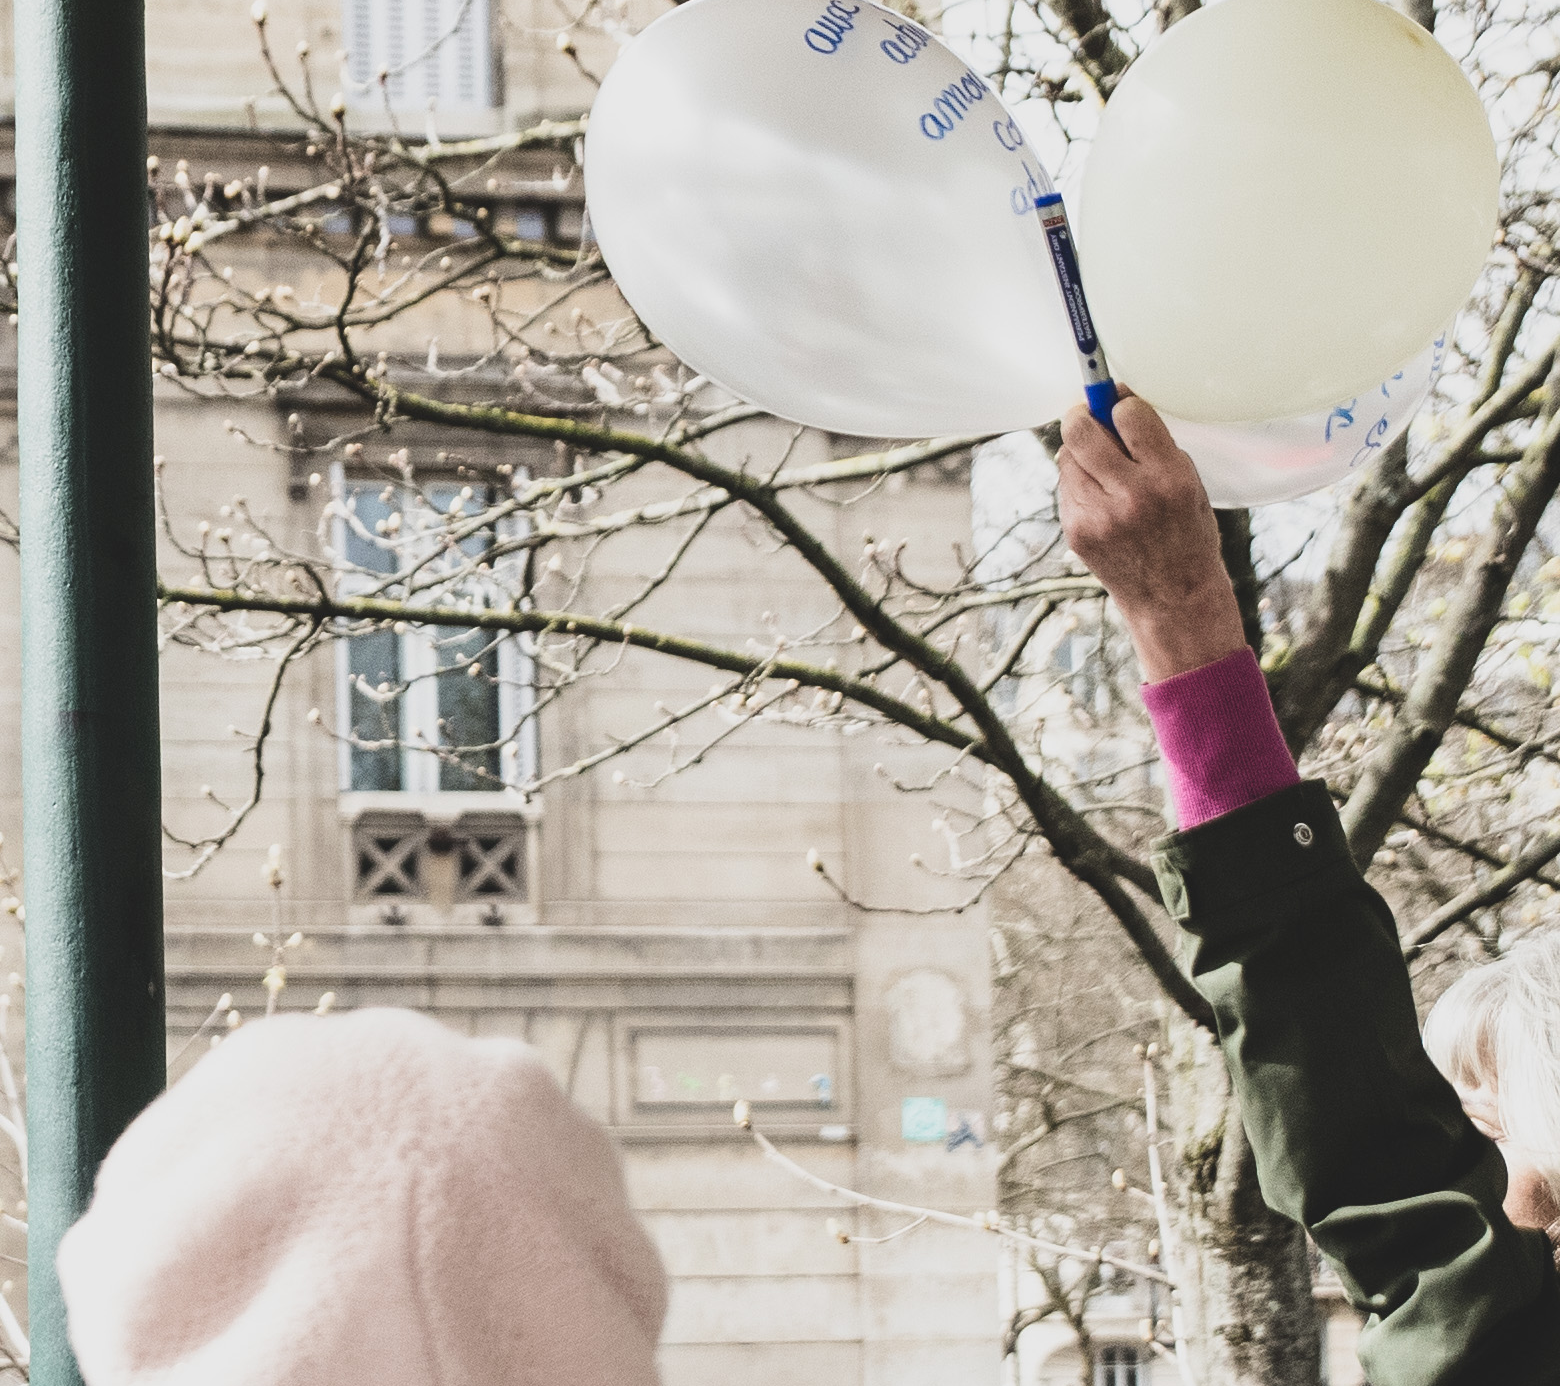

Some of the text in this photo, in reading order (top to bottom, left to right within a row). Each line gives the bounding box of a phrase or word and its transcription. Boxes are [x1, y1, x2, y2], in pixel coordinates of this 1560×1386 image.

[920, 68, 991, 141] amou
[1050, 234, 1061, 251] DRY
[1055, 253, 1071, 289] INSTANT
[1066, 290, 1085, 342] PERMANENT
[1072, 282, 1093, 341] WATERPROOF
